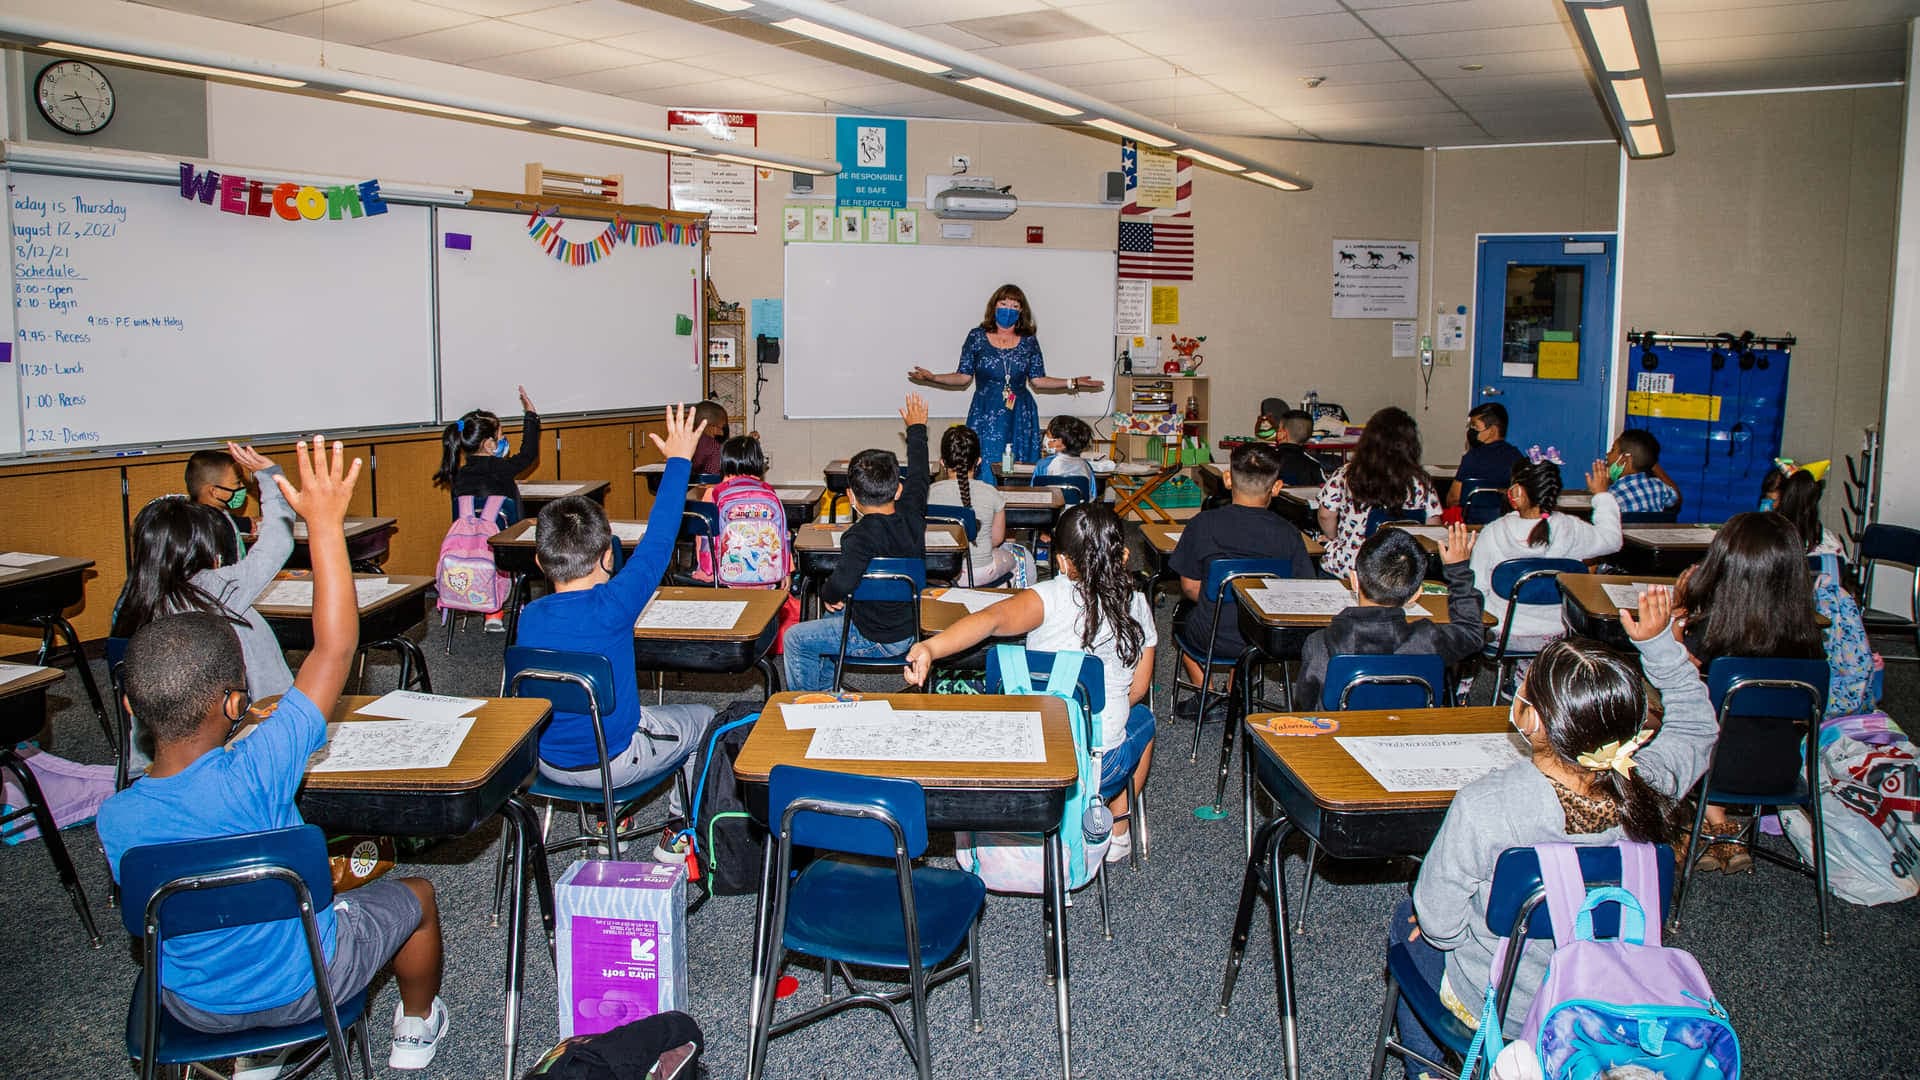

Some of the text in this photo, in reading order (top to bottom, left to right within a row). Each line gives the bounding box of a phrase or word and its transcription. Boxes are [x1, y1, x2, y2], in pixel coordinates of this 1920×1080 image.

[839, 172, 905, 182] BE RESPONSIBLE
[180, 162, 388, 221] WELCOME
[856, 186, 887, 194] BE SAFE
[14, 195, 127, 223] oday is Thursday
[852, 199, 902, 208] RESPECTFUL
[15, 243, 69, 264] 8/12/21
[15, 263, 80, 278] Schedule
[601, 968, 656, 981] ultra soft
